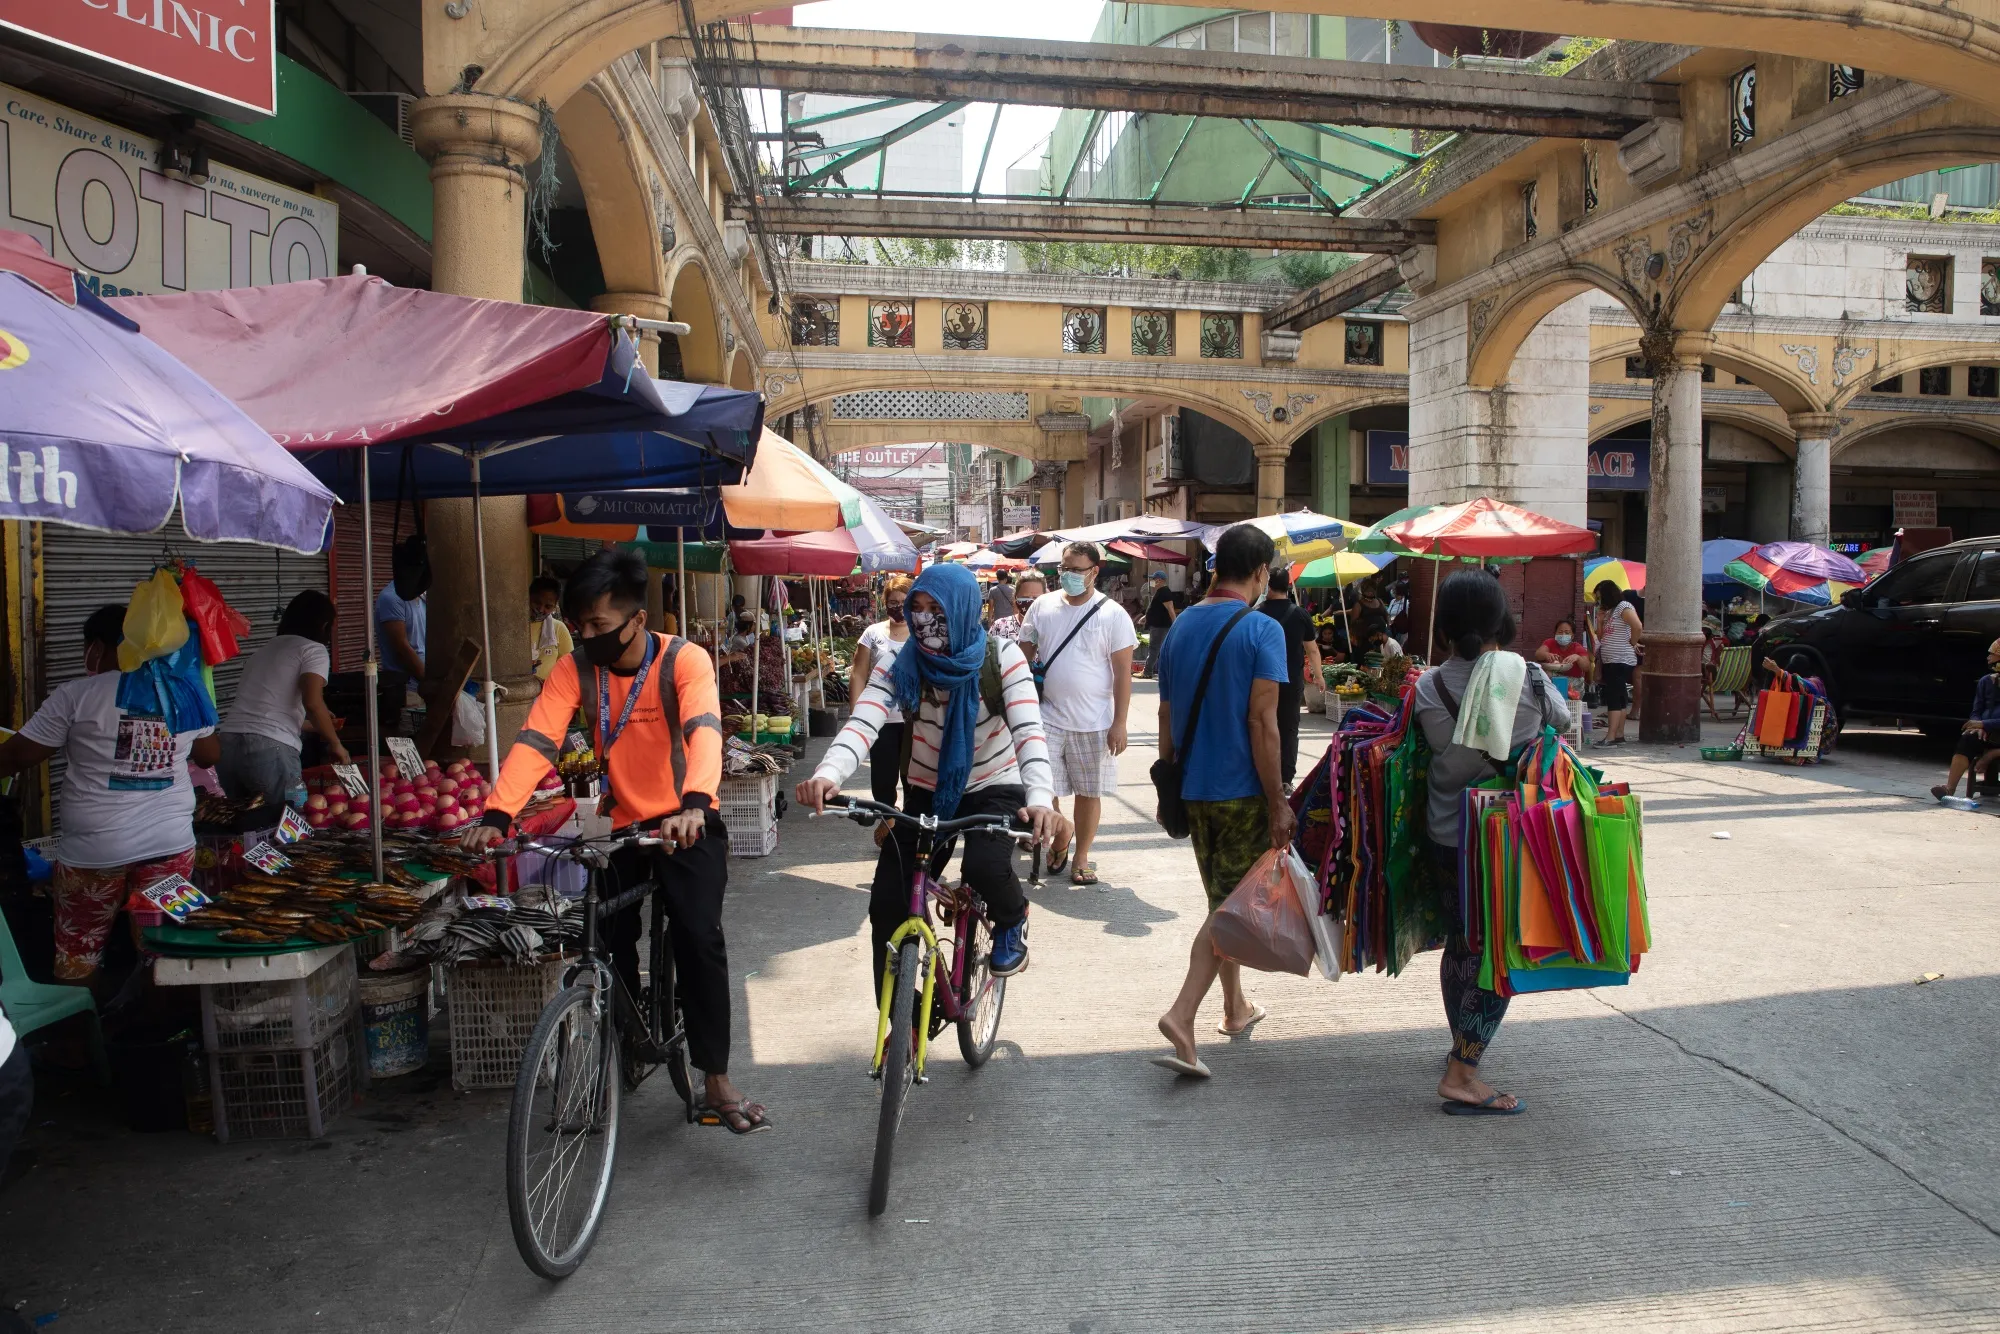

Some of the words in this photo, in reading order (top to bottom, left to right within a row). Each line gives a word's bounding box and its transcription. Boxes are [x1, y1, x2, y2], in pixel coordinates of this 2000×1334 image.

[82, 0, 256, 62] LINIC
[7, 100, 49, 128] Care,
[53, 117, 98, 143] Share
[101, 135, 113, 149] &
[119, 139, 148, 161] Win.
[220, 178, 238, 193] na,
[240, 184, 281, 206] suwerte
[283, 200, 299, 212] mo
[300, 206, 316, 218] pa.
[865, 450, 917, 464] OUTLET
[604, 500, 703, 516] MICROMATIC
[159, 885, 207, 917] 60
